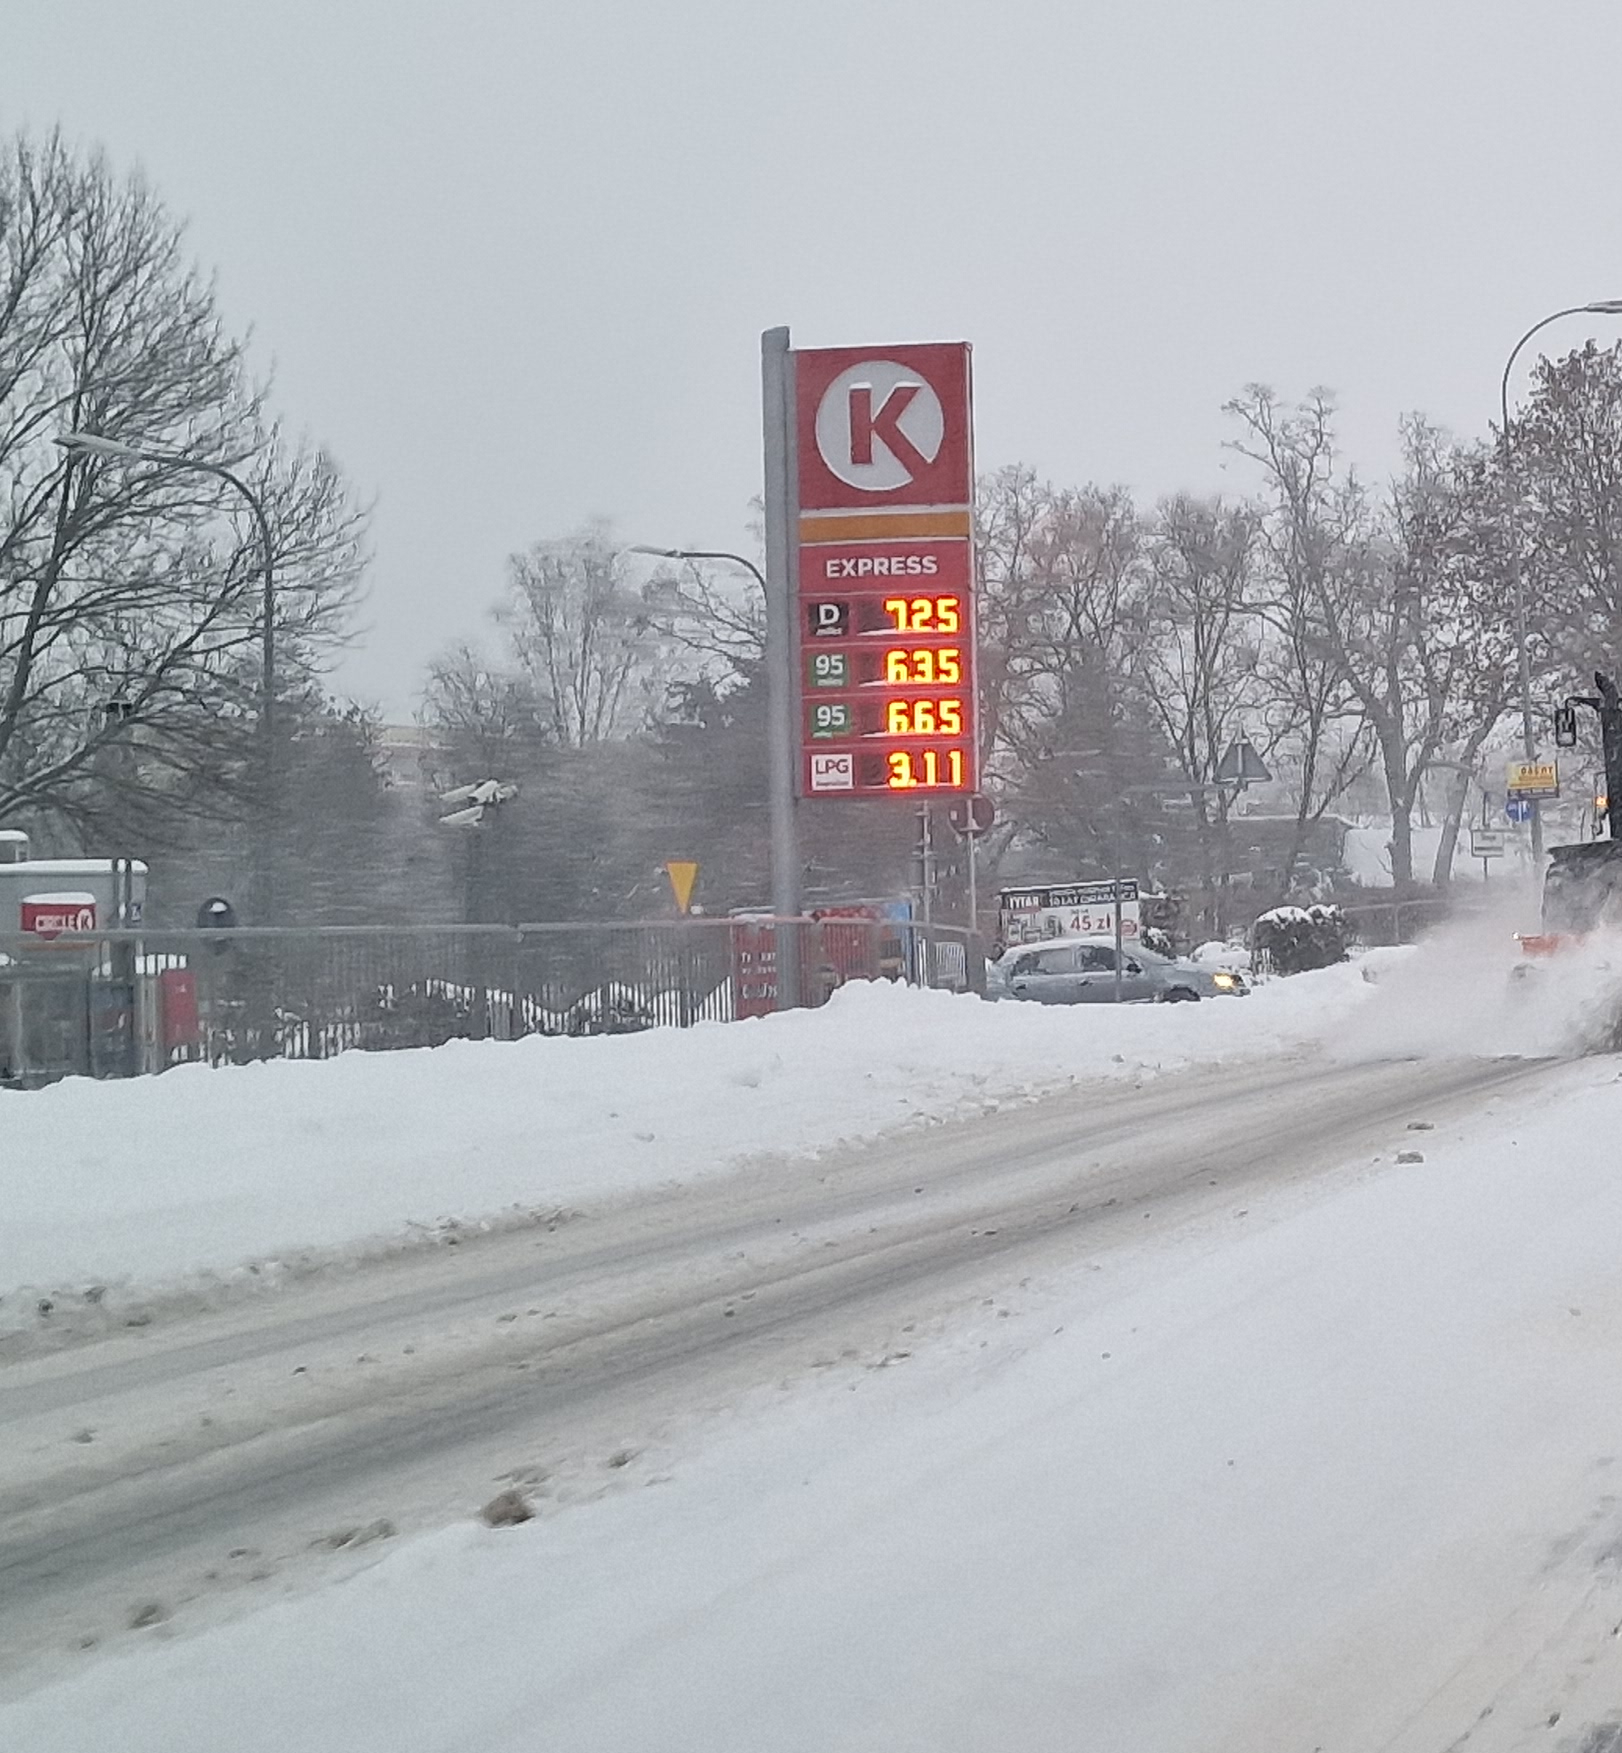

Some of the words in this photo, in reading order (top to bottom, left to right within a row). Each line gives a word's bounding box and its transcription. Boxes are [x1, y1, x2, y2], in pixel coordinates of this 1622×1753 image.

[825, 555, 938, 579] EXPRESS
[818, 603, 840, 625] D
[815, 654, 844, 675] 95
[817, 705, 846, 728] 95
[815, 758, 850, 775] LPG
[888, 751, 962, 788] 3.11
[1070, 916, 1091, 932] 45
